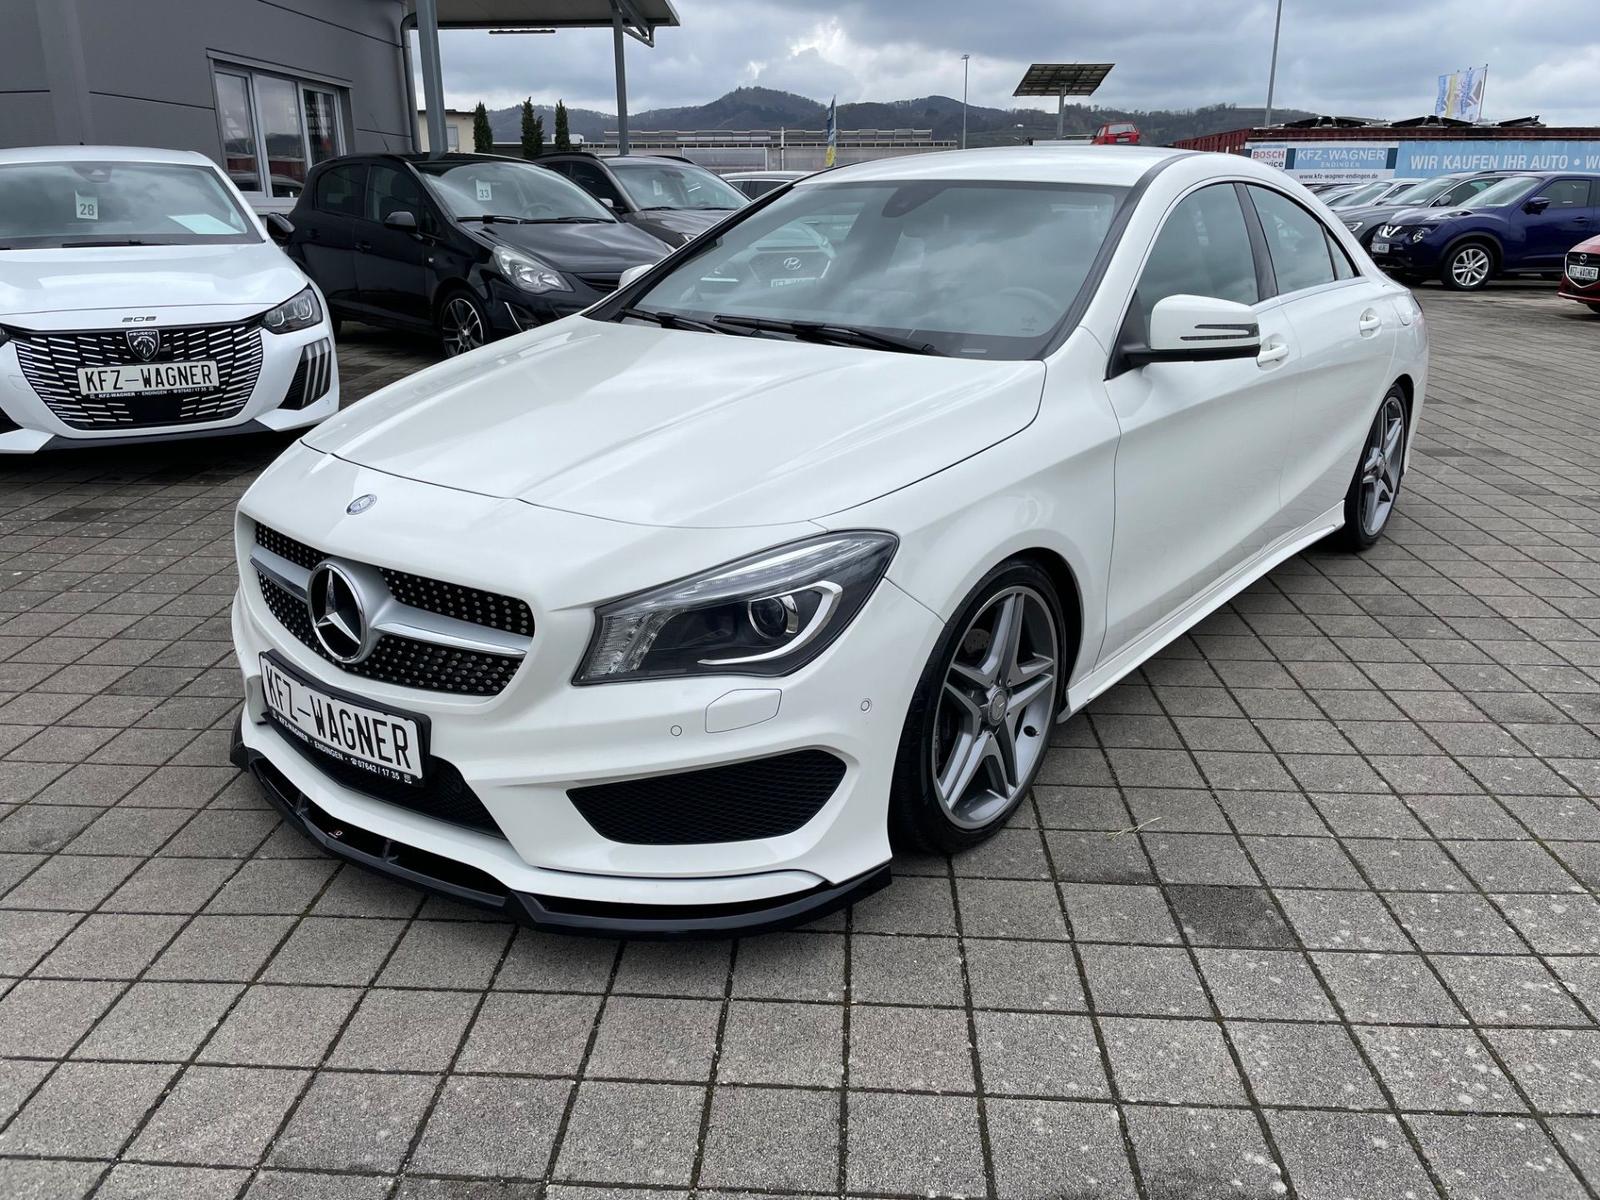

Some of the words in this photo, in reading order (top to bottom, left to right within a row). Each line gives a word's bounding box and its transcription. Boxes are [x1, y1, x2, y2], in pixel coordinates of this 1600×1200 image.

[1253, 151, 1284, 159] BOSCH
[1297, 150, 1385, 160] KFZ-WAGNER
[1411, 155, 1438, 169] WIR
[1443, 155, 1499, 169] KAUFEN
[1503, 155, 1527, 169] IHR
[1530, 155, 1568, 169] AUTO
[1299, 171, 1379, 180] www.kfz-wagner-endingen.de
[479, 189, 490, 199] 33
[79, 203, 95, 216] 28
[85, 365, 213, 391] KFZ-WAGNER
[265, 665, 412, 769] KFZ-WAGNER
[314, 741, 344, 760] ENDINGEN
[357, 760, 377, 773] 07642
[390, 771, 400, 780] 35
